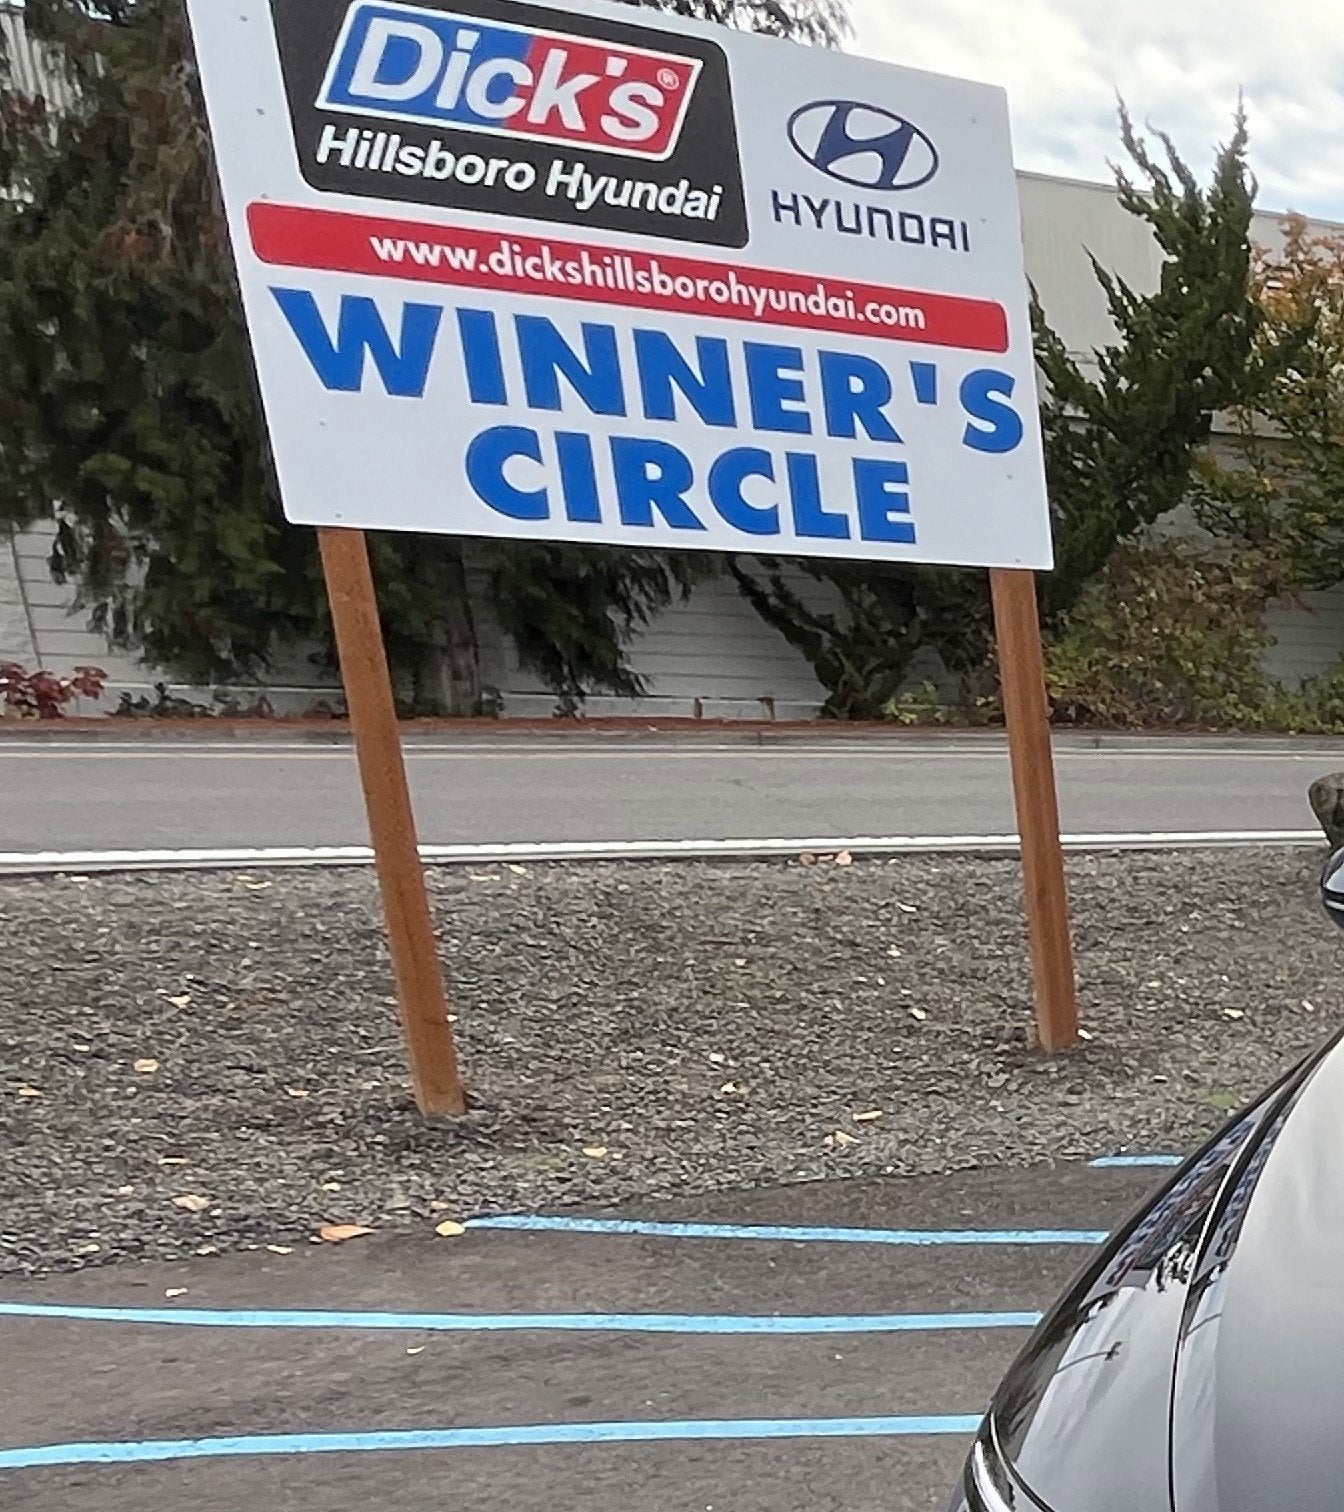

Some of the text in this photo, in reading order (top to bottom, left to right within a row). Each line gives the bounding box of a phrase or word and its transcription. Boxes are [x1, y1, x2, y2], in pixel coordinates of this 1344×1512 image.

[348, 14, 666, 143] Dick's
[315, 123, 723, 222] Hillsboro Hyundai
[771, 190, 971, 254] HYUNDAI
[369, 229, 927, 332] www.dickshillsborohyundai.com
[267, 285, 1024, 453] WINNER'S
[464, 423, 917, 545] CIRCLE
